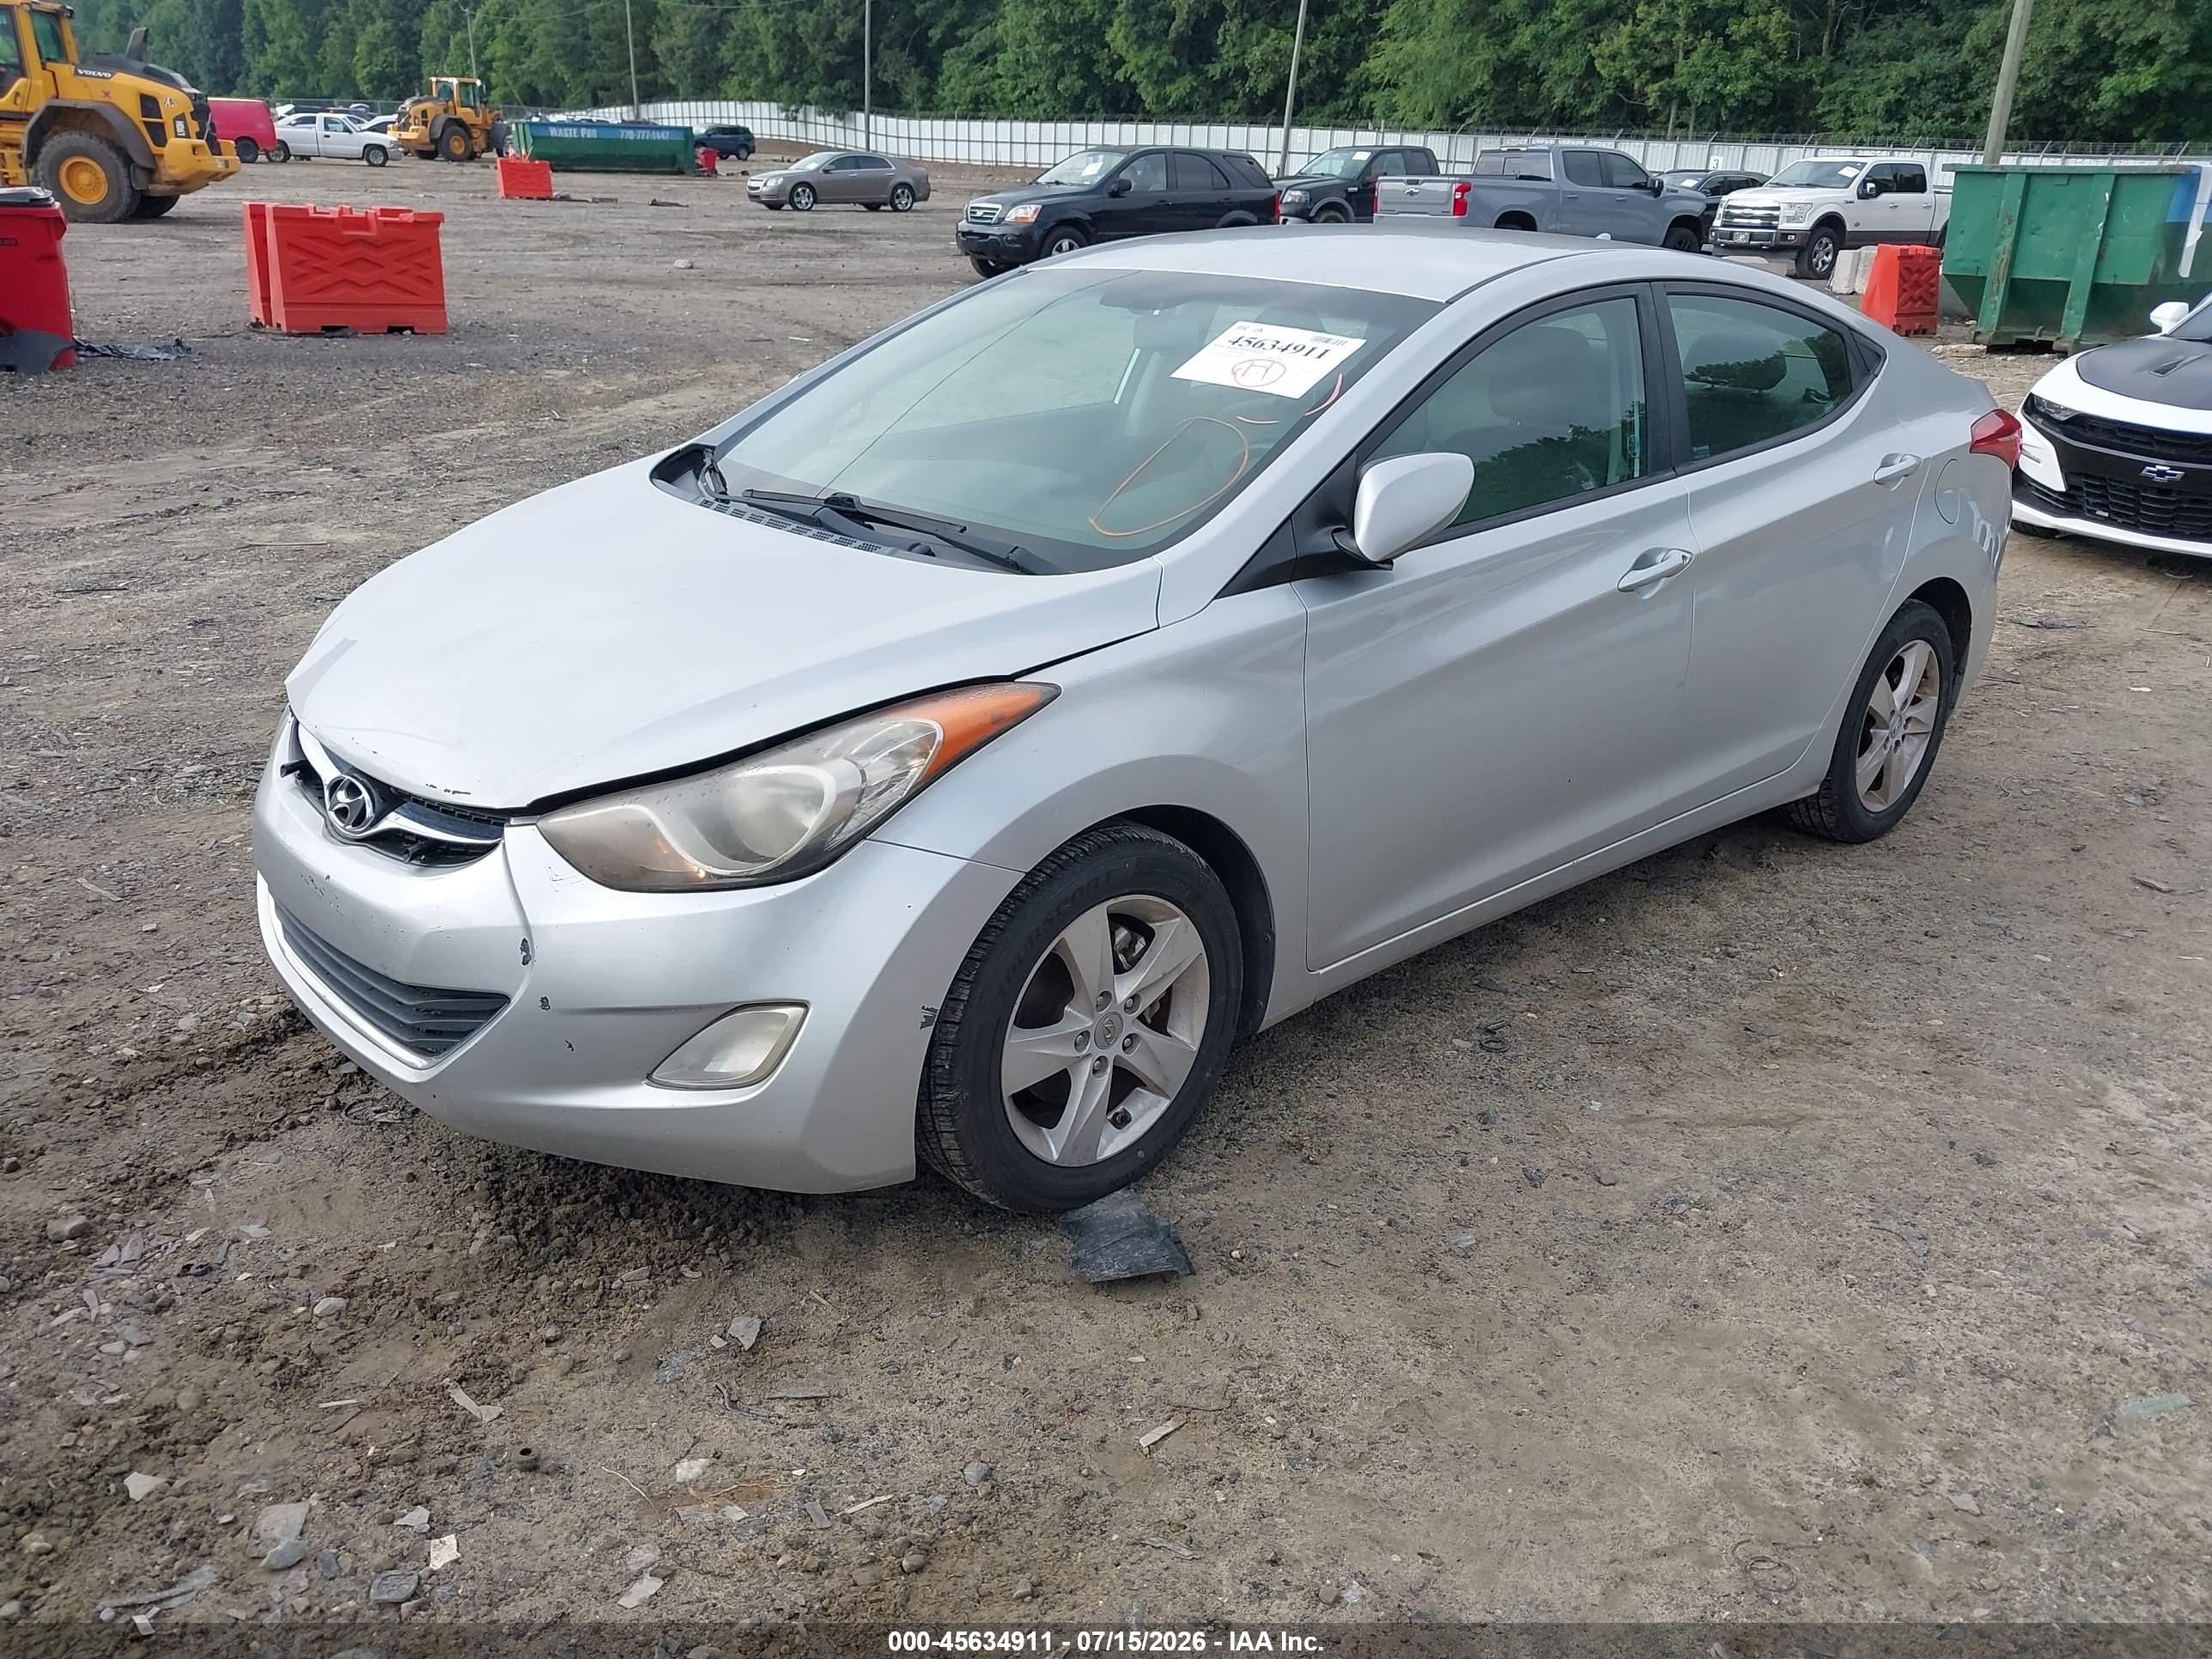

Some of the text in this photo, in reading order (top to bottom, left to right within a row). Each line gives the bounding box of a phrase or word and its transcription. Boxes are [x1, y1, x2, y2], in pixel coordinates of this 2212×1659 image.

[77, 69, 112, 78] VOLVO
[1713, 159, 1719, 170] 3
[1227, 335, 1331, 359] 45634911
